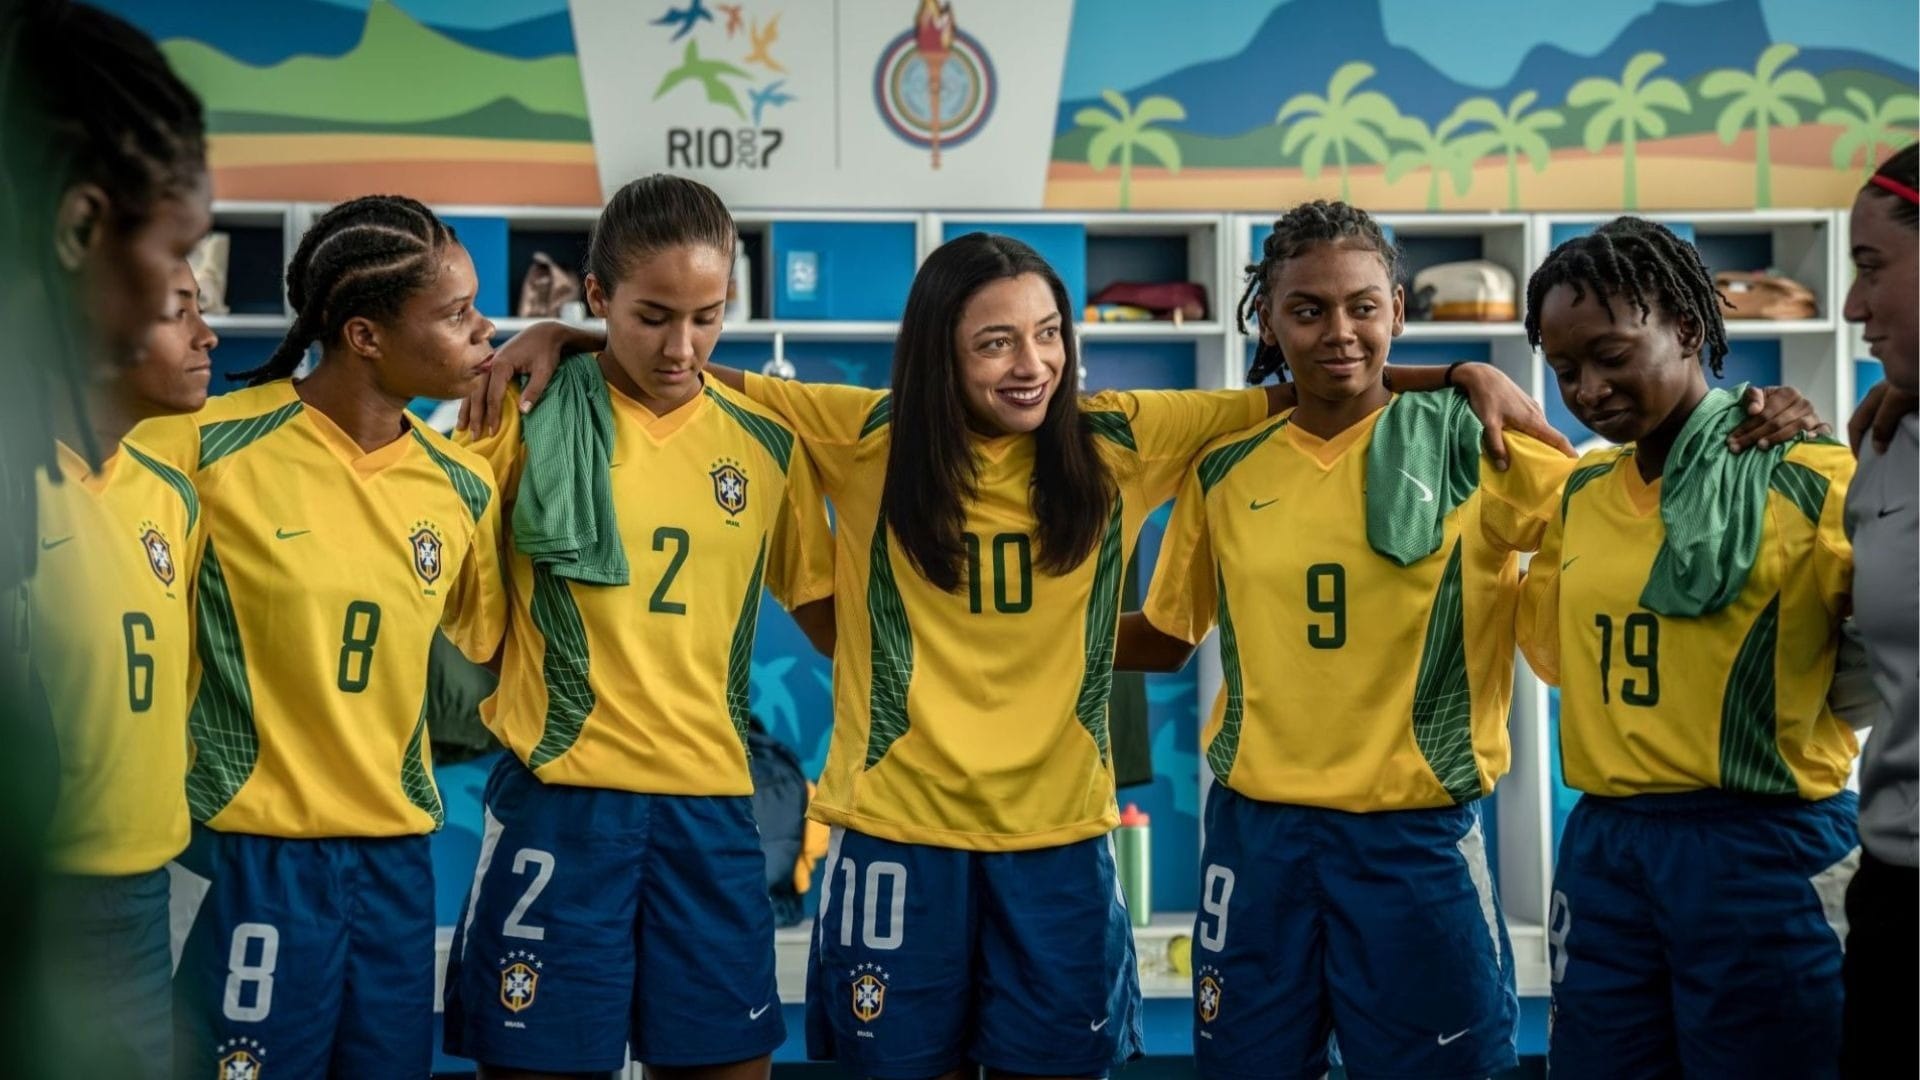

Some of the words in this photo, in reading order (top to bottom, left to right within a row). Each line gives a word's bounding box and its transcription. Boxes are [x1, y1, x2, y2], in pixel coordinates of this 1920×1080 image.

[667, 128, 733, 169] RIO
[648, 526, 690, 616] 2
[961, 532, 1033, 614] 10
[1306, 563, 1346, 650] 9
[122, 611, 155, 713] 6
[337, 600, 381, 694] 8
[1595, 612, 1660, 707] 19
[502, 847, 555, 941] 2
[840, 857, 908, 950] 10
[1200, 863, 1235, 953] 9
[222, 922, 280, 1023] 8
